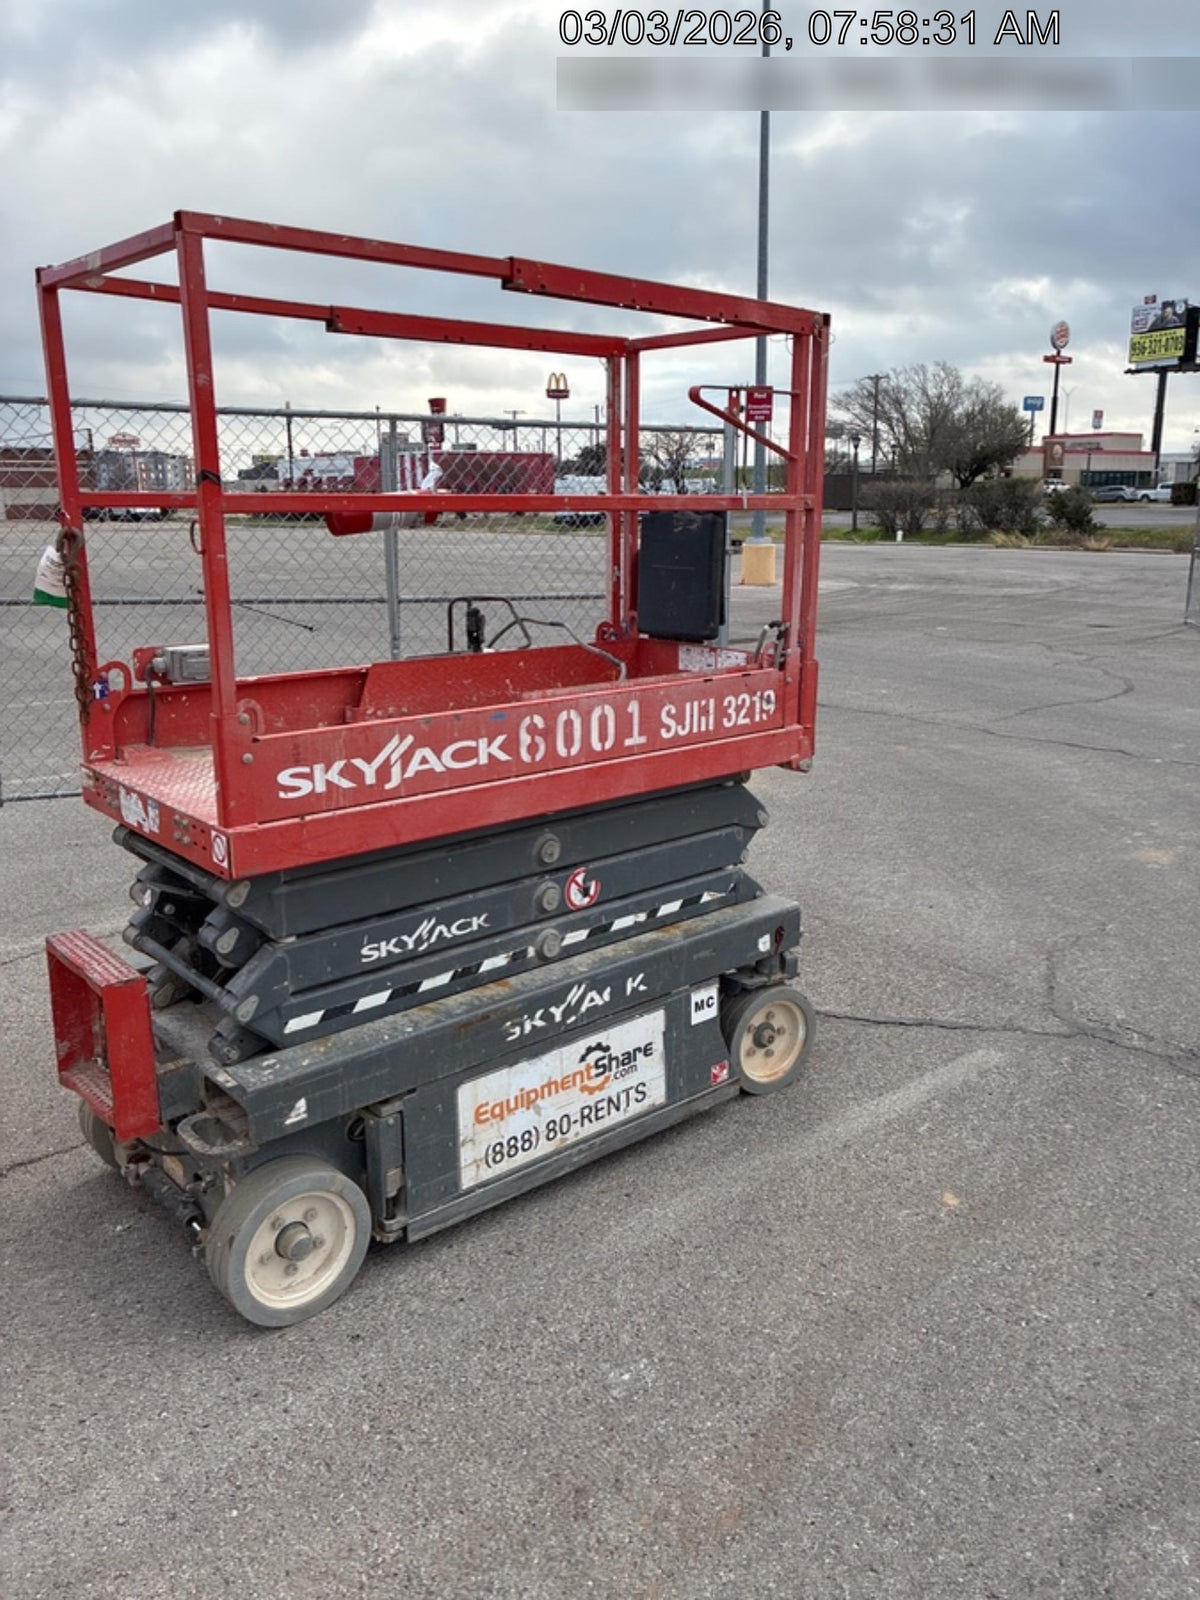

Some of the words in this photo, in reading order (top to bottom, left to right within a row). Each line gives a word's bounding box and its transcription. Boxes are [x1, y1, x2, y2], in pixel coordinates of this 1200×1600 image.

[722, 689, 776, 728] 3219
[276, 733, 512, 800] SKYJACK
[518, 699, 648, 764] 6001
[360, 913, 491, 962] SKYJACK
[694, 996, 715, 1013] MC
[473, 1041, 654, 1125] EquipmentShare
[483, 1126, 540, 1169] (888)
[545, 1082, 648, 1142] 80-RENTS
